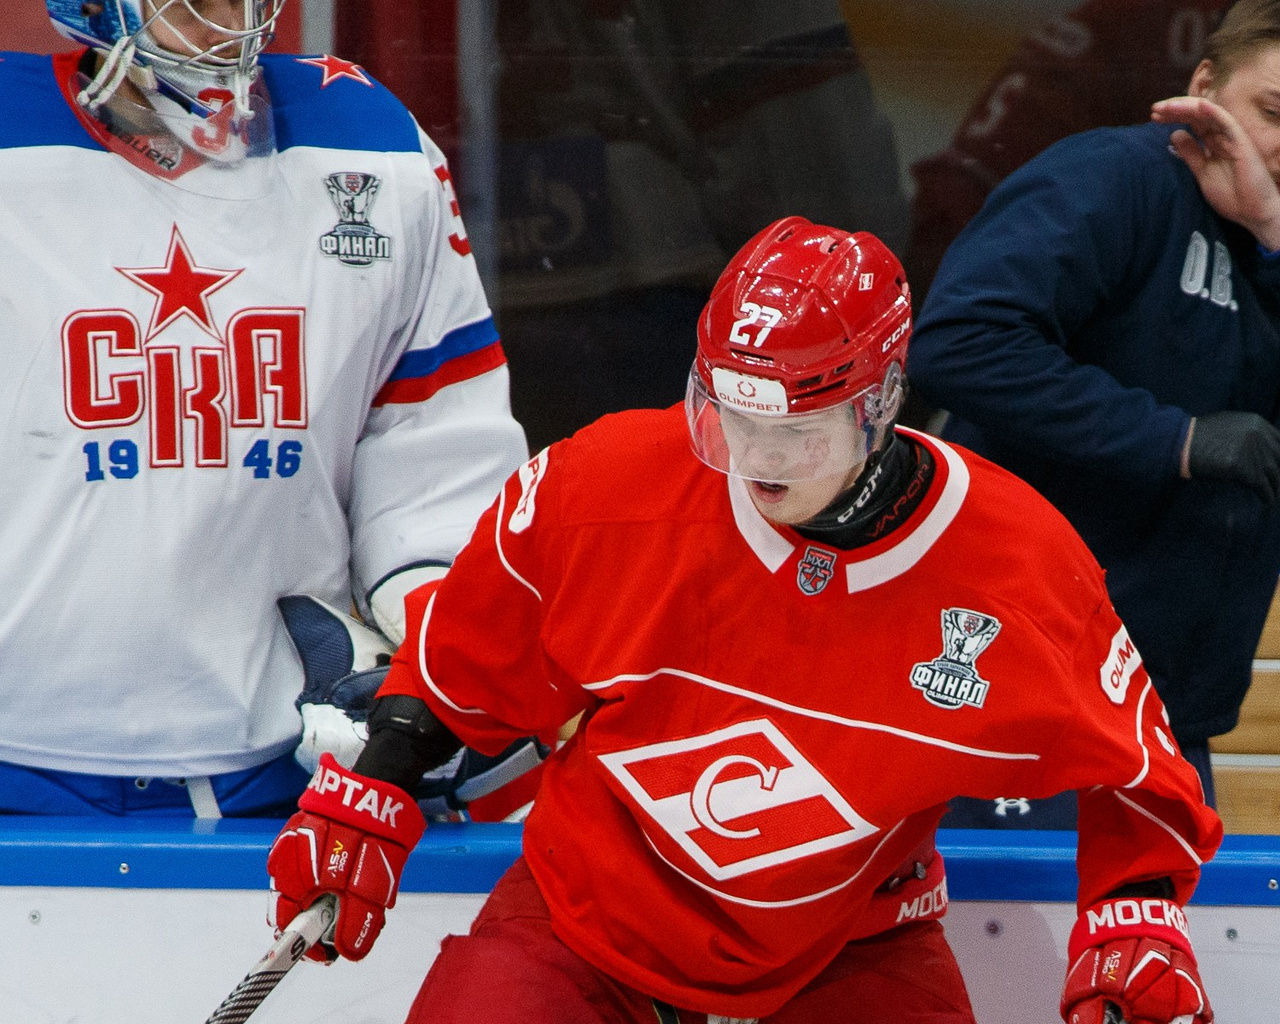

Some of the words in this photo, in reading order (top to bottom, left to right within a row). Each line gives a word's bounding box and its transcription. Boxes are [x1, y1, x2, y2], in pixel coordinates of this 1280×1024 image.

[320, 235, 390, 258] ФИНАЛ
[729, 302, 783, 348] 27
[882, 317, 911, 353] CCM
[61, 307, 307, 469] СКА
[719, 392, 782, 413] OLIMPBET
[83, 440, 138, 482] 19
[243, 440, 303, 479] 46
[913, 666, 987, 704] ФИНАЛ
